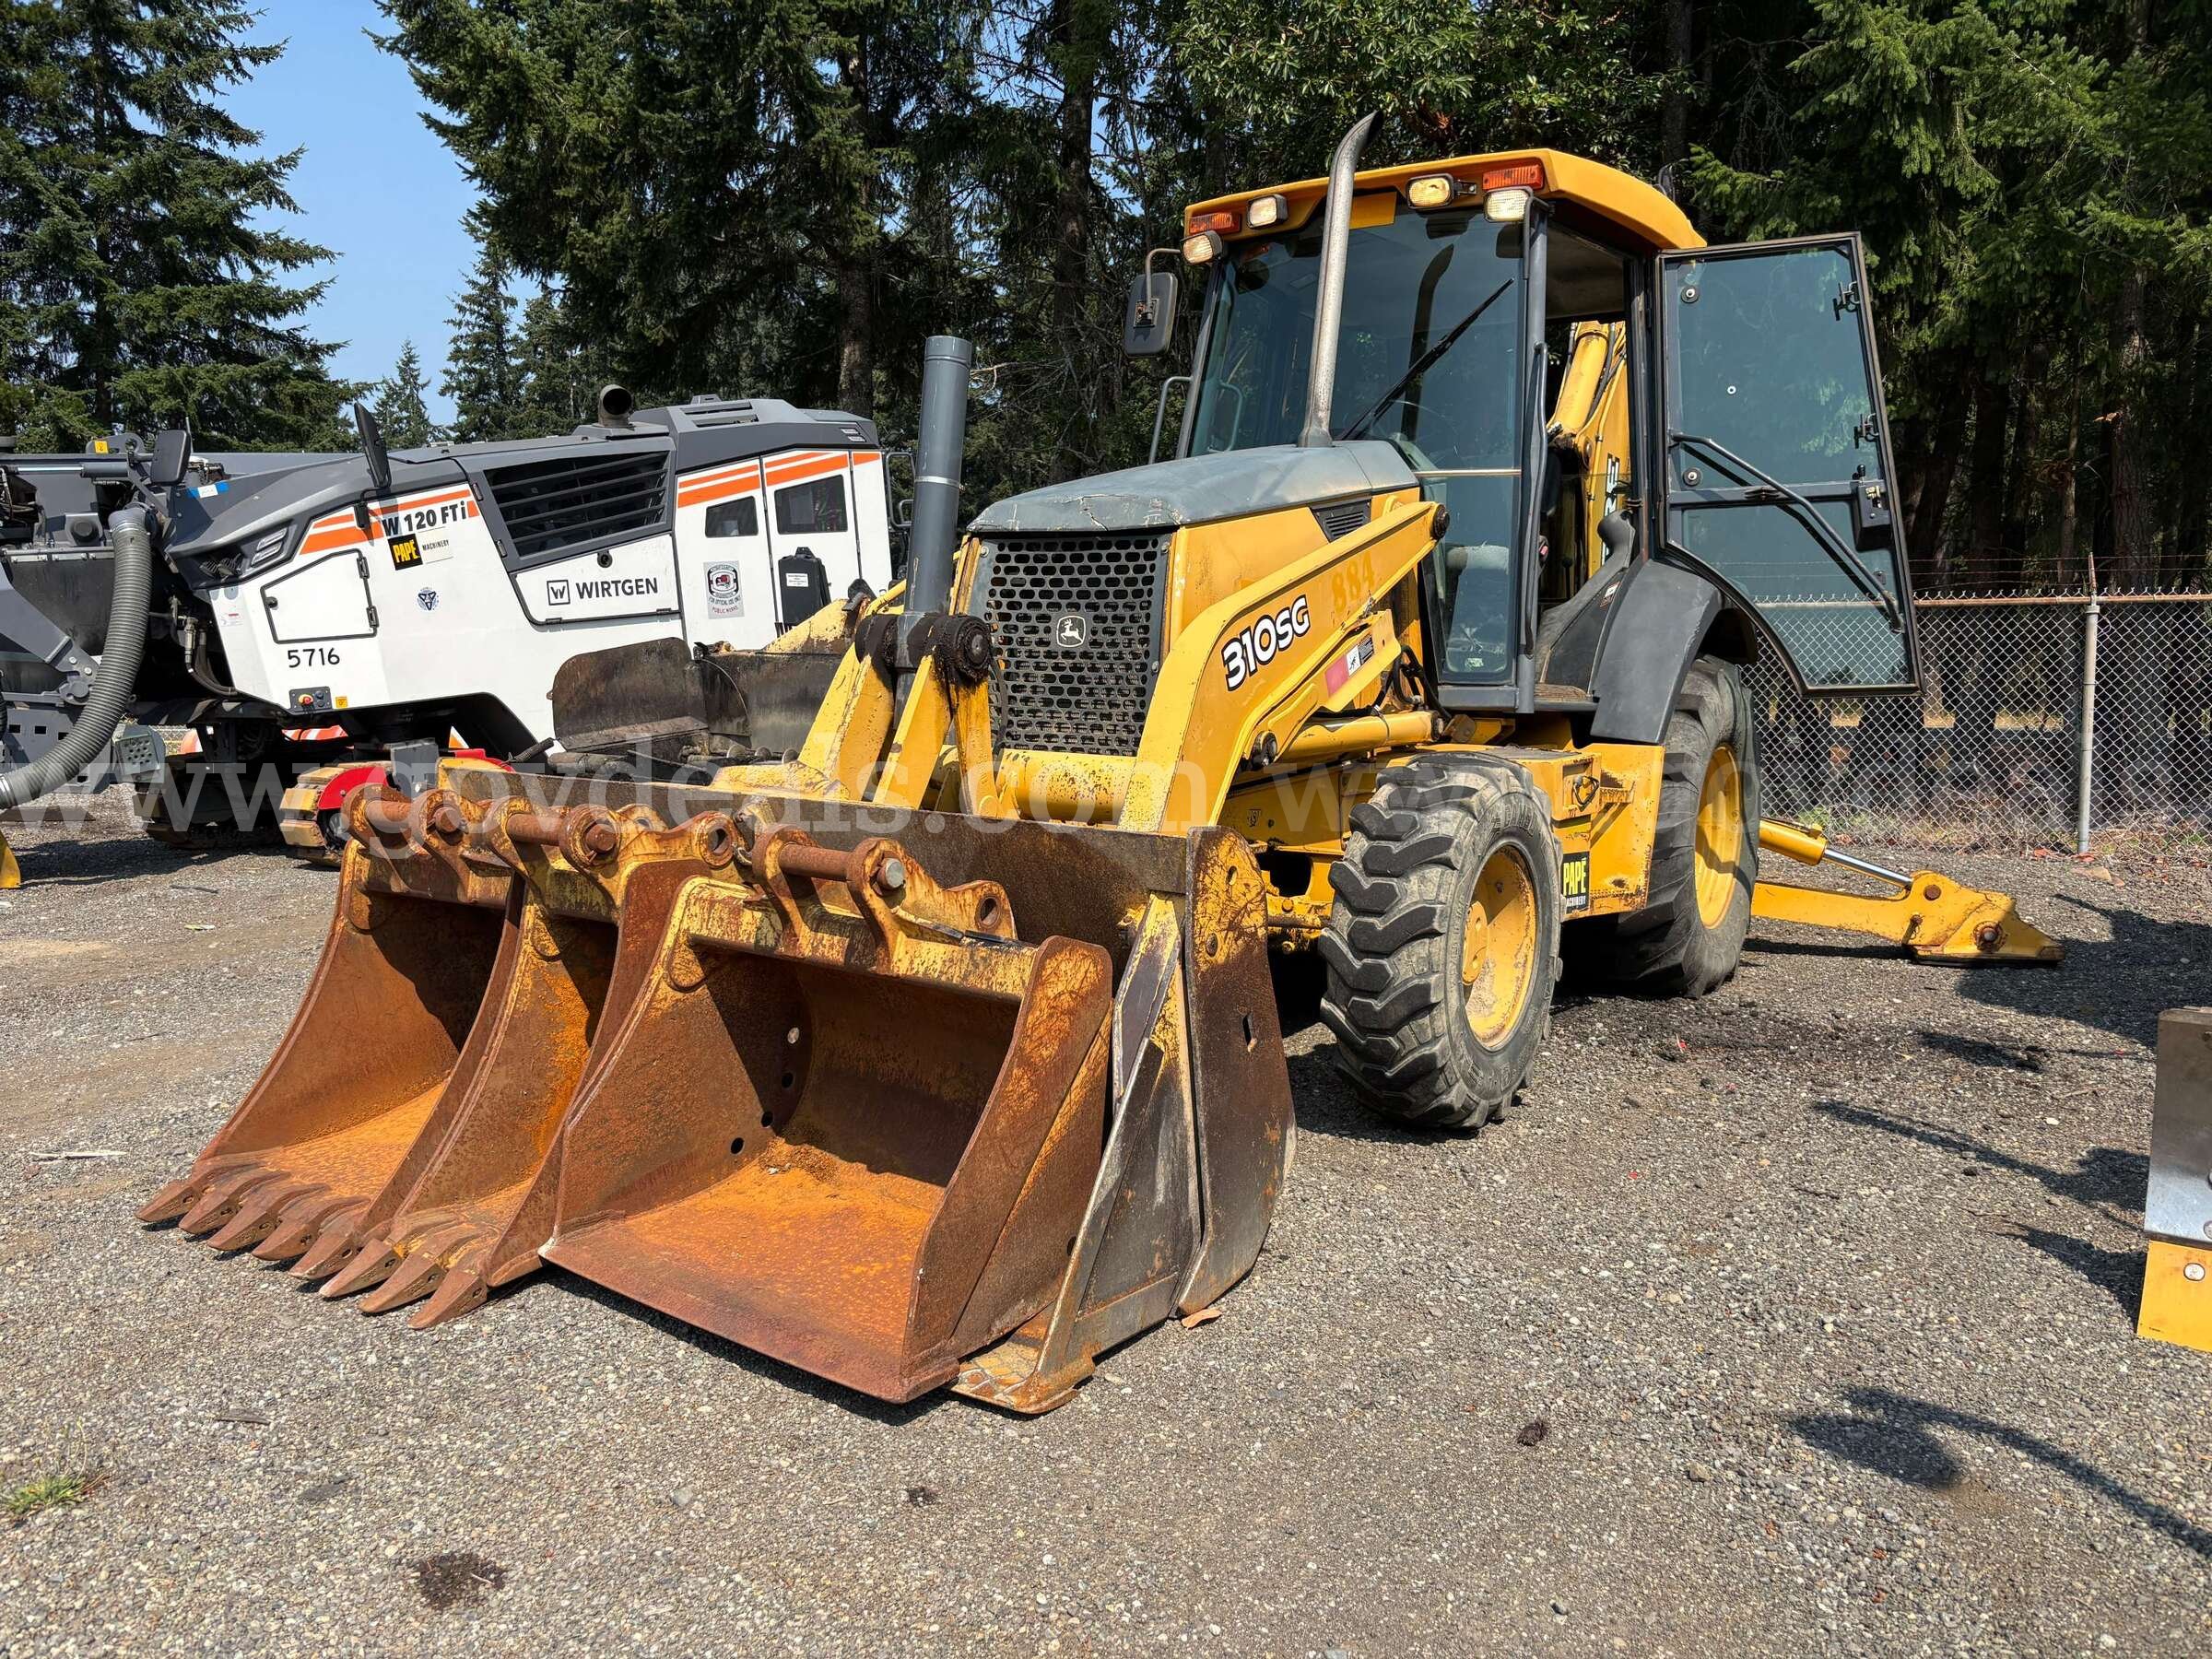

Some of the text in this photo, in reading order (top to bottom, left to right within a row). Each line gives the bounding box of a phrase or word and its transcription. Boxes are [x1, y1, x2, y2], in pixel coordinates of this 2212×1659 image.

[382, 516, 400, 536] W
[404, 509, 437, 532] 120
[422, 539, 449, 550] MACHINERY
[575, 577, 659, 599] WIRTGEN
[1333, 550, 1374, 615] 884
[1221, 594, 1311, 691] 310SG
[288, 647, 340, 668] 5716
